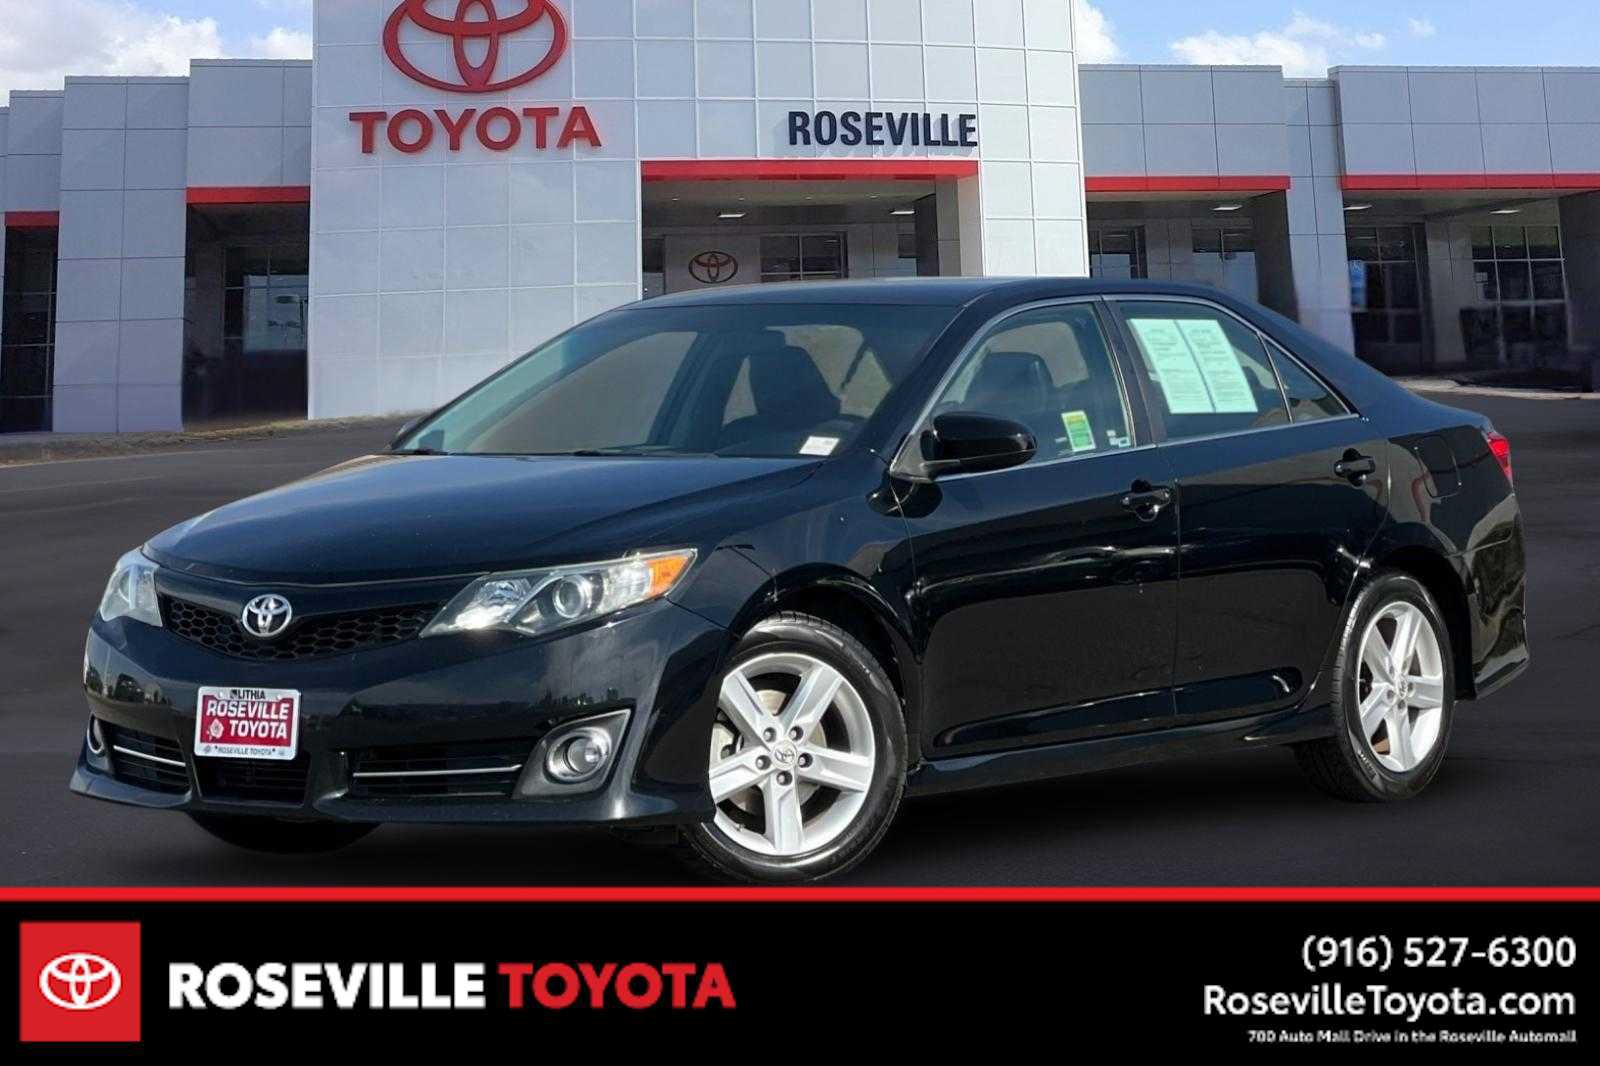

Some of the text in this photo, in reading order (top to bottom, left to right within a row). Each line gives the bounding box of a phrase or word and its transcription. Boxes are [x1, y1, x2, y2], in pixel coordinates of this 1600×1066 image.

[349, 106, 602, 154] TOYOTA
[788, 111, 978, 147] ROSEVILLE
[238, 689, 266, 700] LITHIA
[206, 700, 290, 719] ROSEVILLE
[229, 720, 287, 739] TOYOTA
